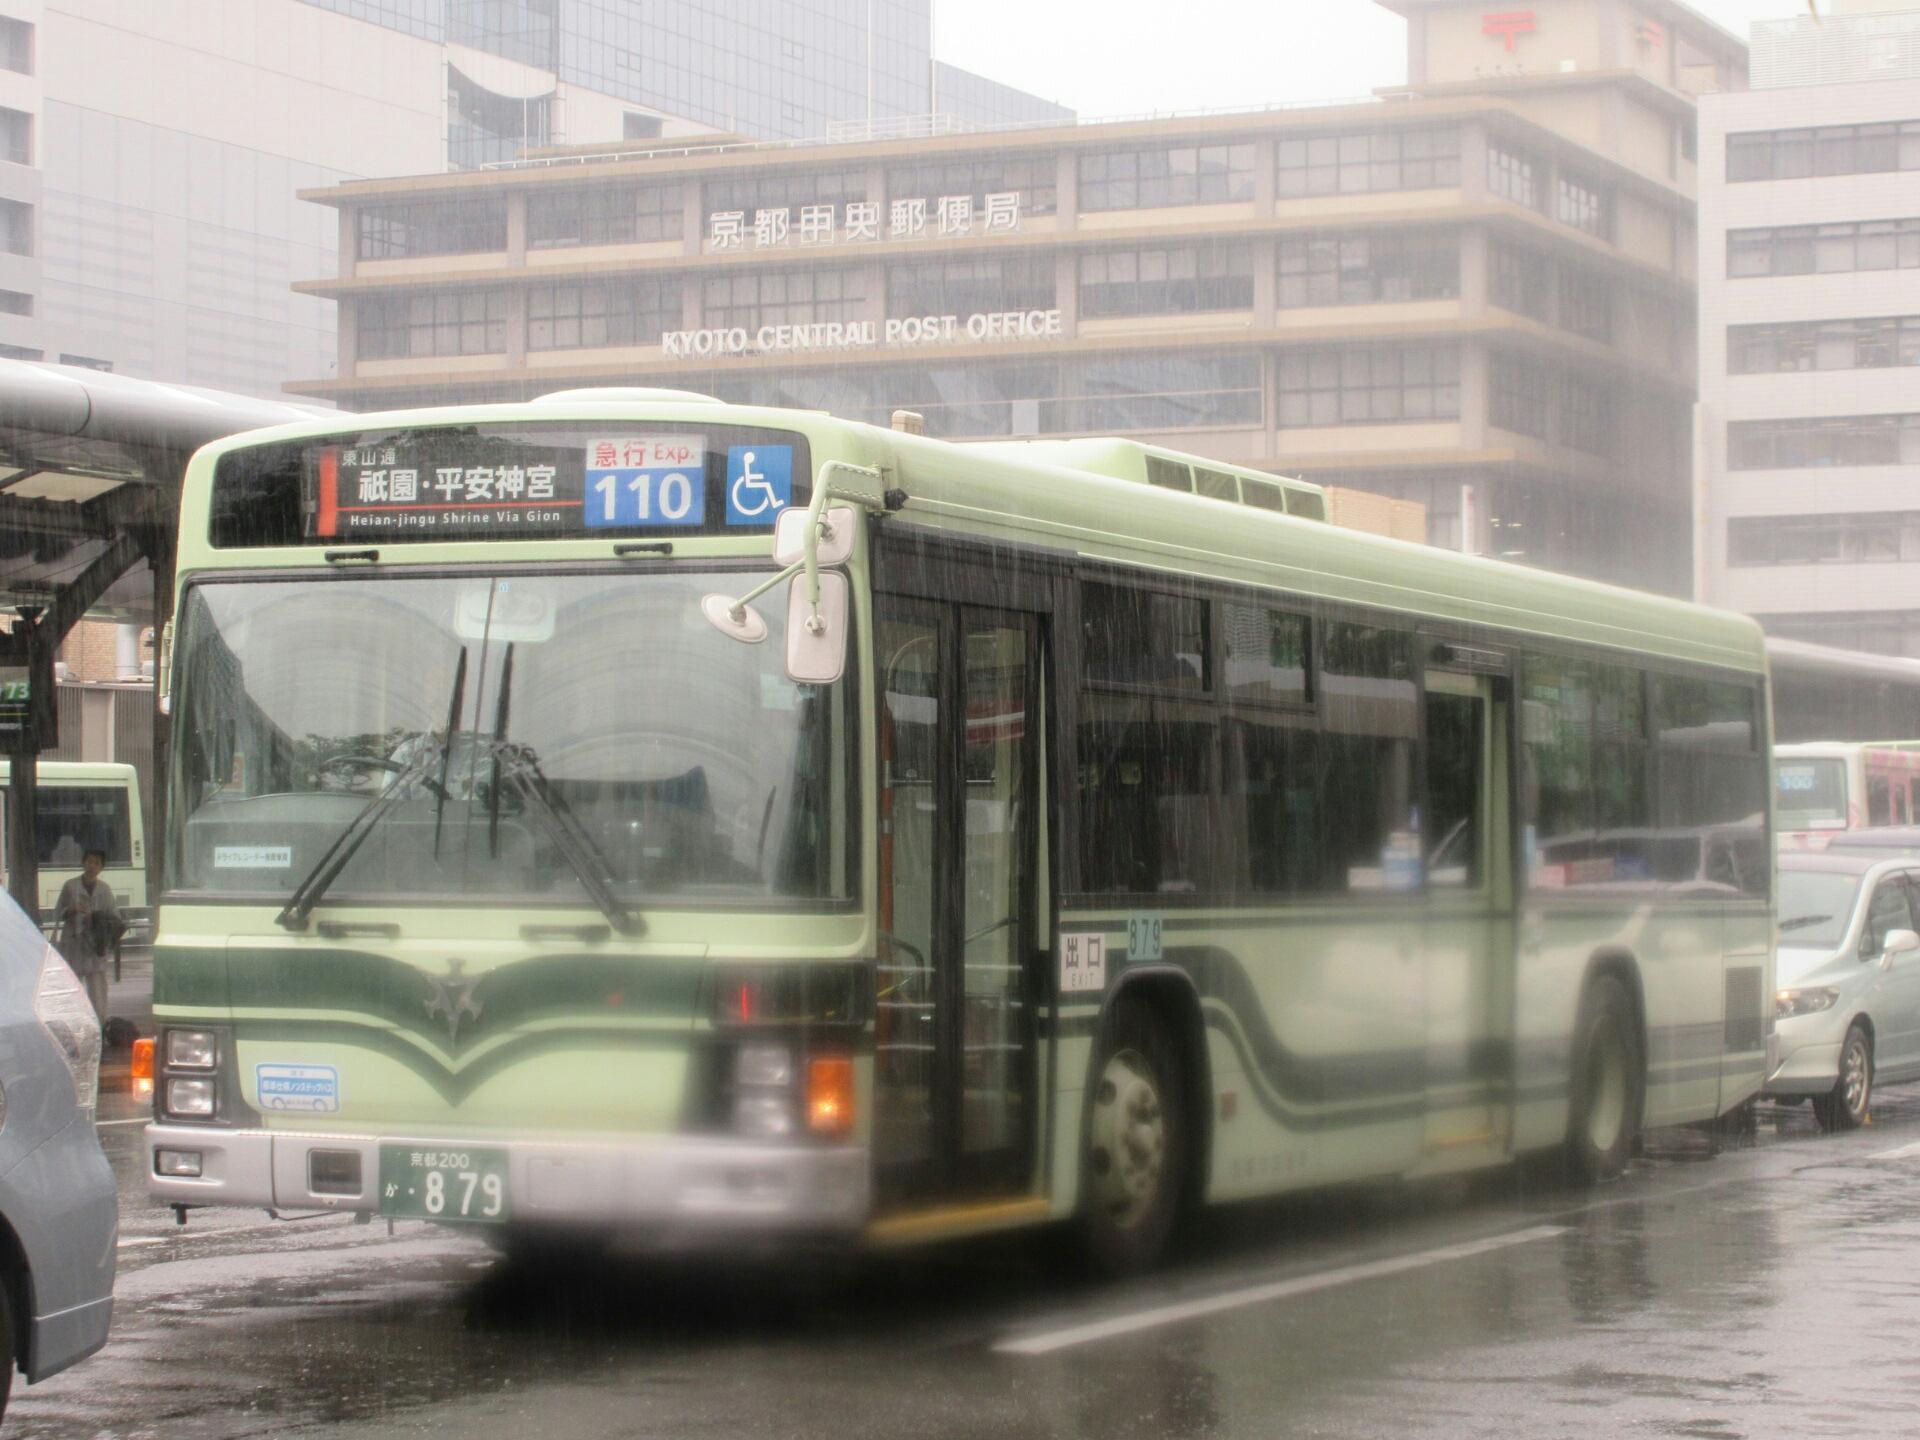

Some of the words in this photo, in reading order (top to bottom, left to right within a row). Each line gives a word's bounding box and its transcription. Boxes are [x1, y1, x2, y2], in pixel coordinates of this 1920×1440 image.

[710, 192, 1020, 249] 京都中央郵便局
[662, 328, 748, 354] KYOTO
[757, 321, 875, 349] CENTRAL
[885, 315, 957, 343] POST
[967, 310, 1062, 338] OFFICE
[595, 440, 647, 467] 急行
[654, 443, 695, 464] Exp.
[359, 464, 556, 503] 祇園・平安神宮
[594, 473, 692, 520] 110
[351, 513, 436, 528] Heian-jingu
[443, 513, 489, 524] Shrine
[497, 511, 519, 522] Via
[526, 511, 561, 522] Gion
[7, 682, 29, 699] 73
[1066, 937, 1100, 968] 出口
[1129, 918, 1161, 956] 879
[1071, 973, 1096, 986] EXIT
